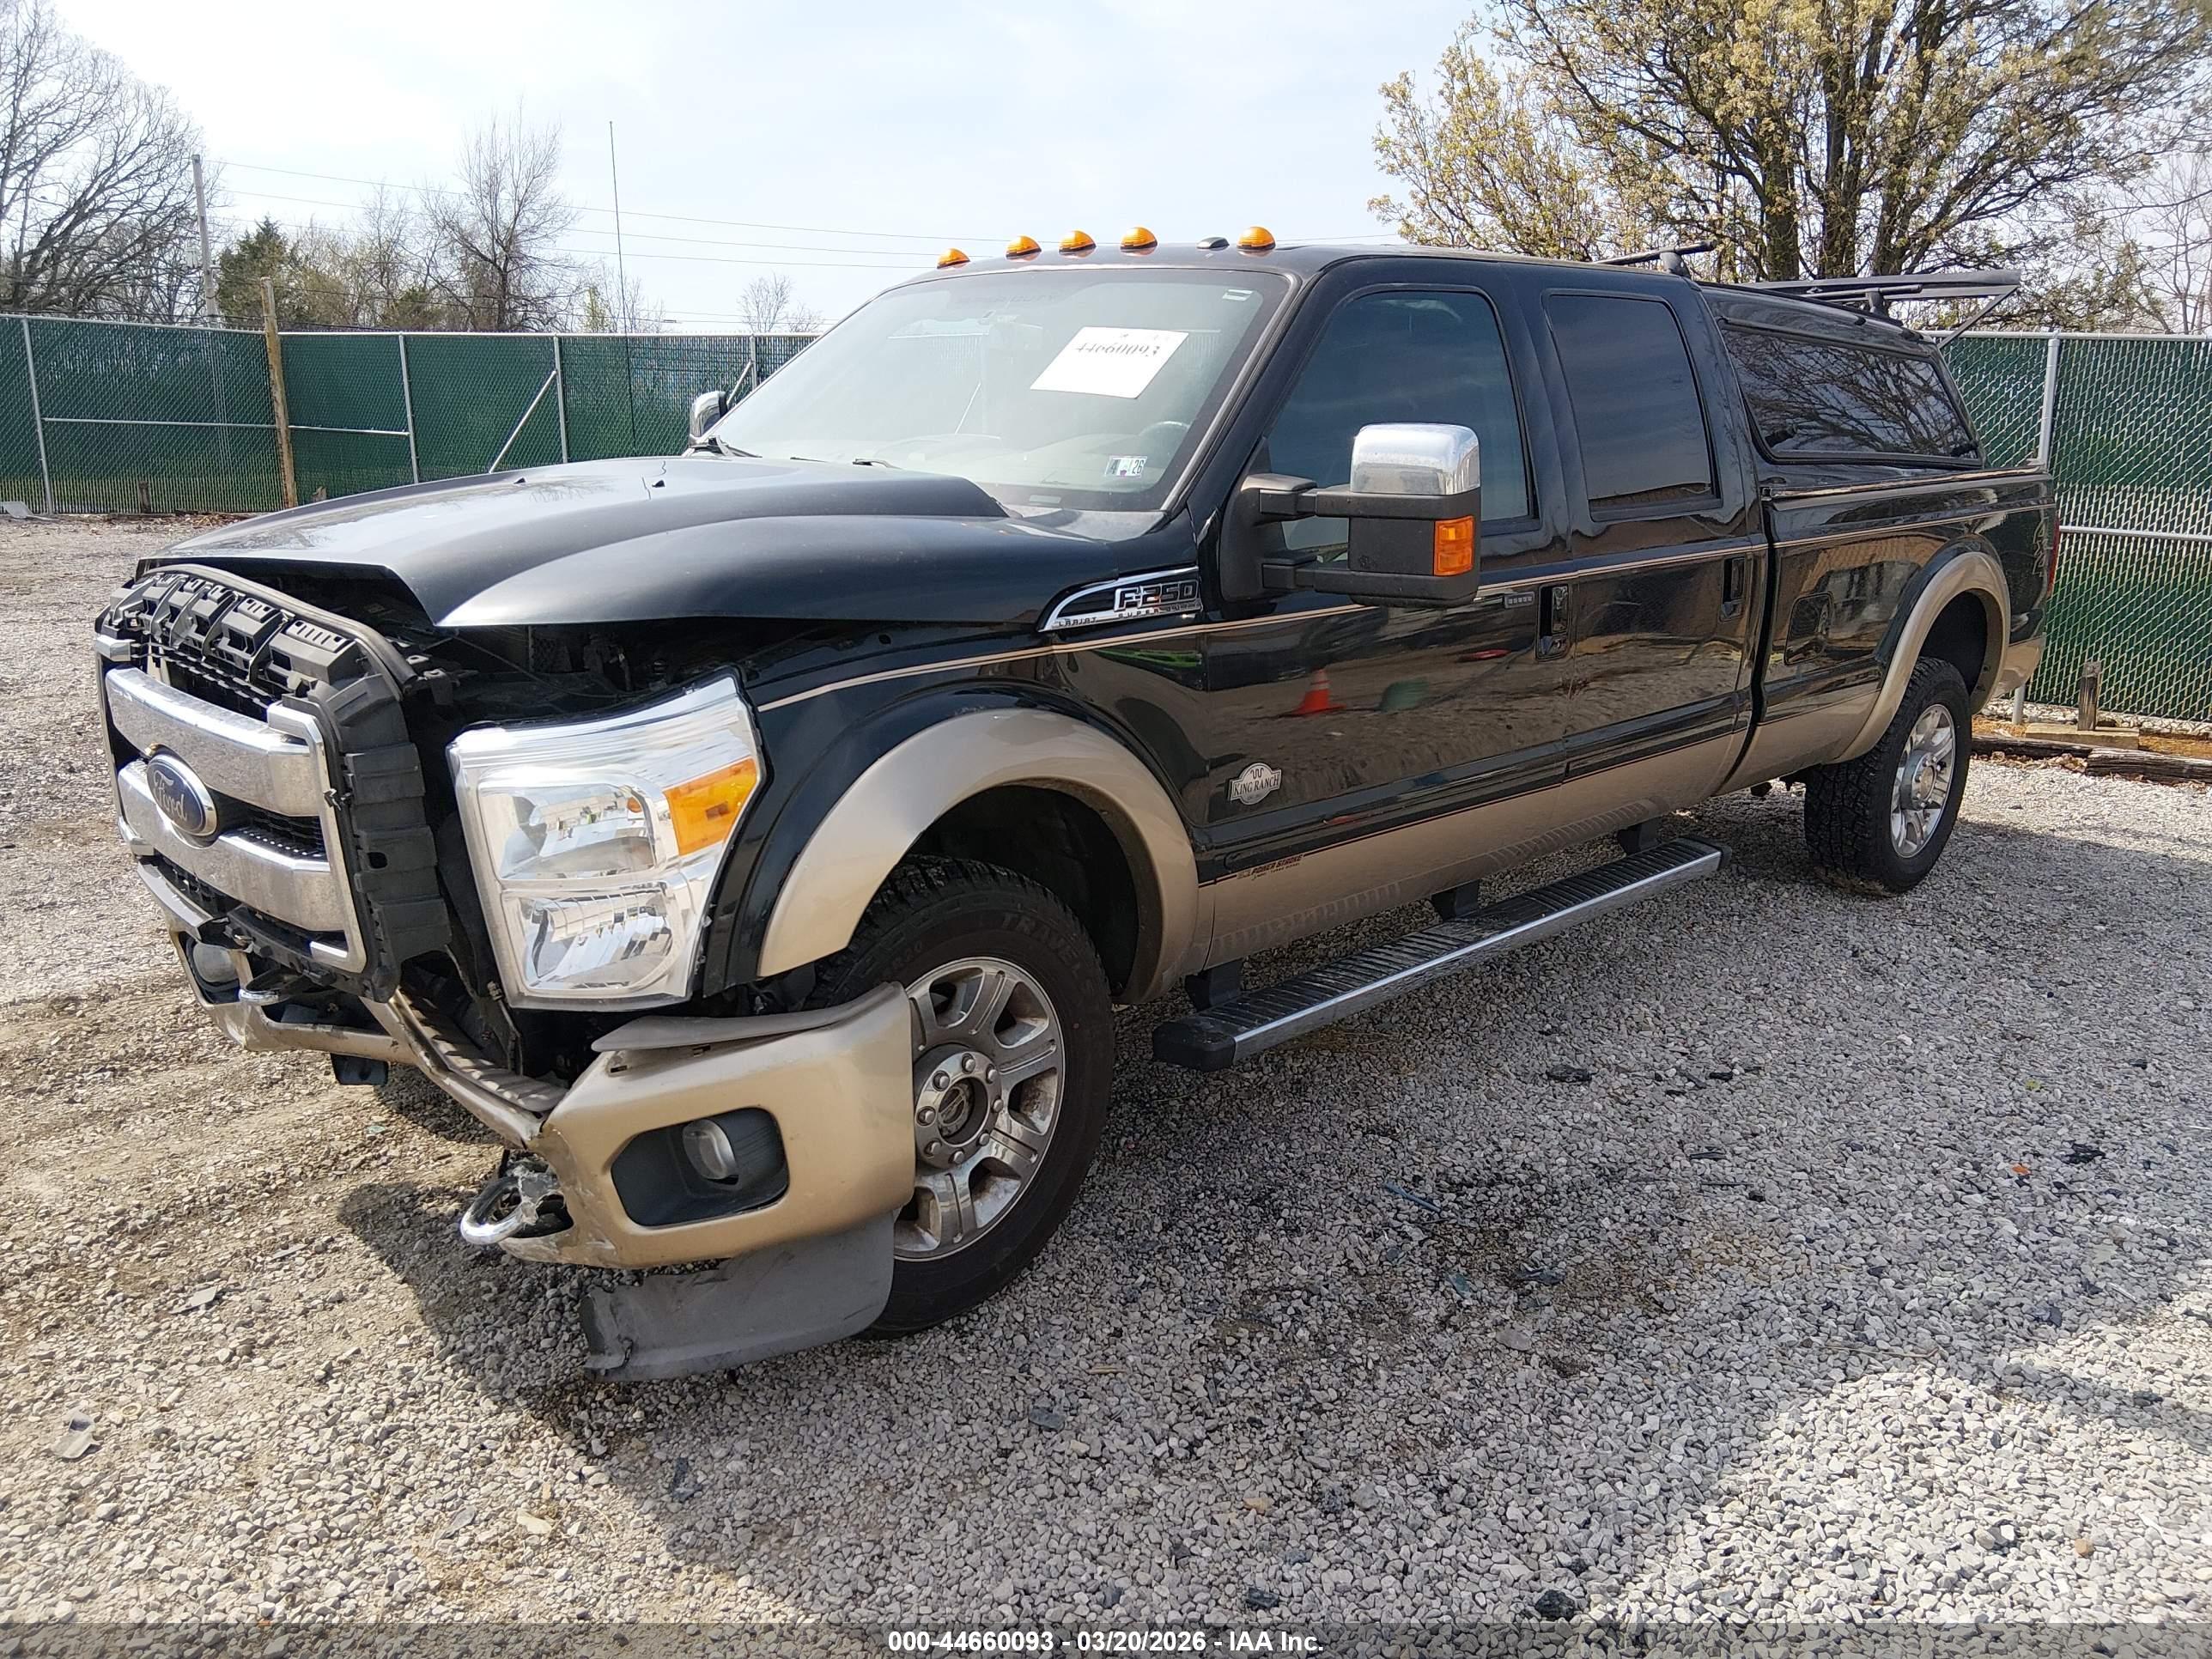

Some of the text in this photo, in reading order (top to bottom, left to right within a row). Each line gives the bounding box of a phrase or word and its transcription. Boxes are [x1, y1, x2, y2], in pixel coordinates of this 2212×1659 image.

[1132, 459, 1145, 474] 26
[1114, 579, 1199, 612] F-250
[1058, 617, 1097, 627] LARIAT
[1118, 608, 1160, 618] SUPER
[153, 769, 187, 822] Ford
[1233, 774, 1279, 797] KING RANCH
